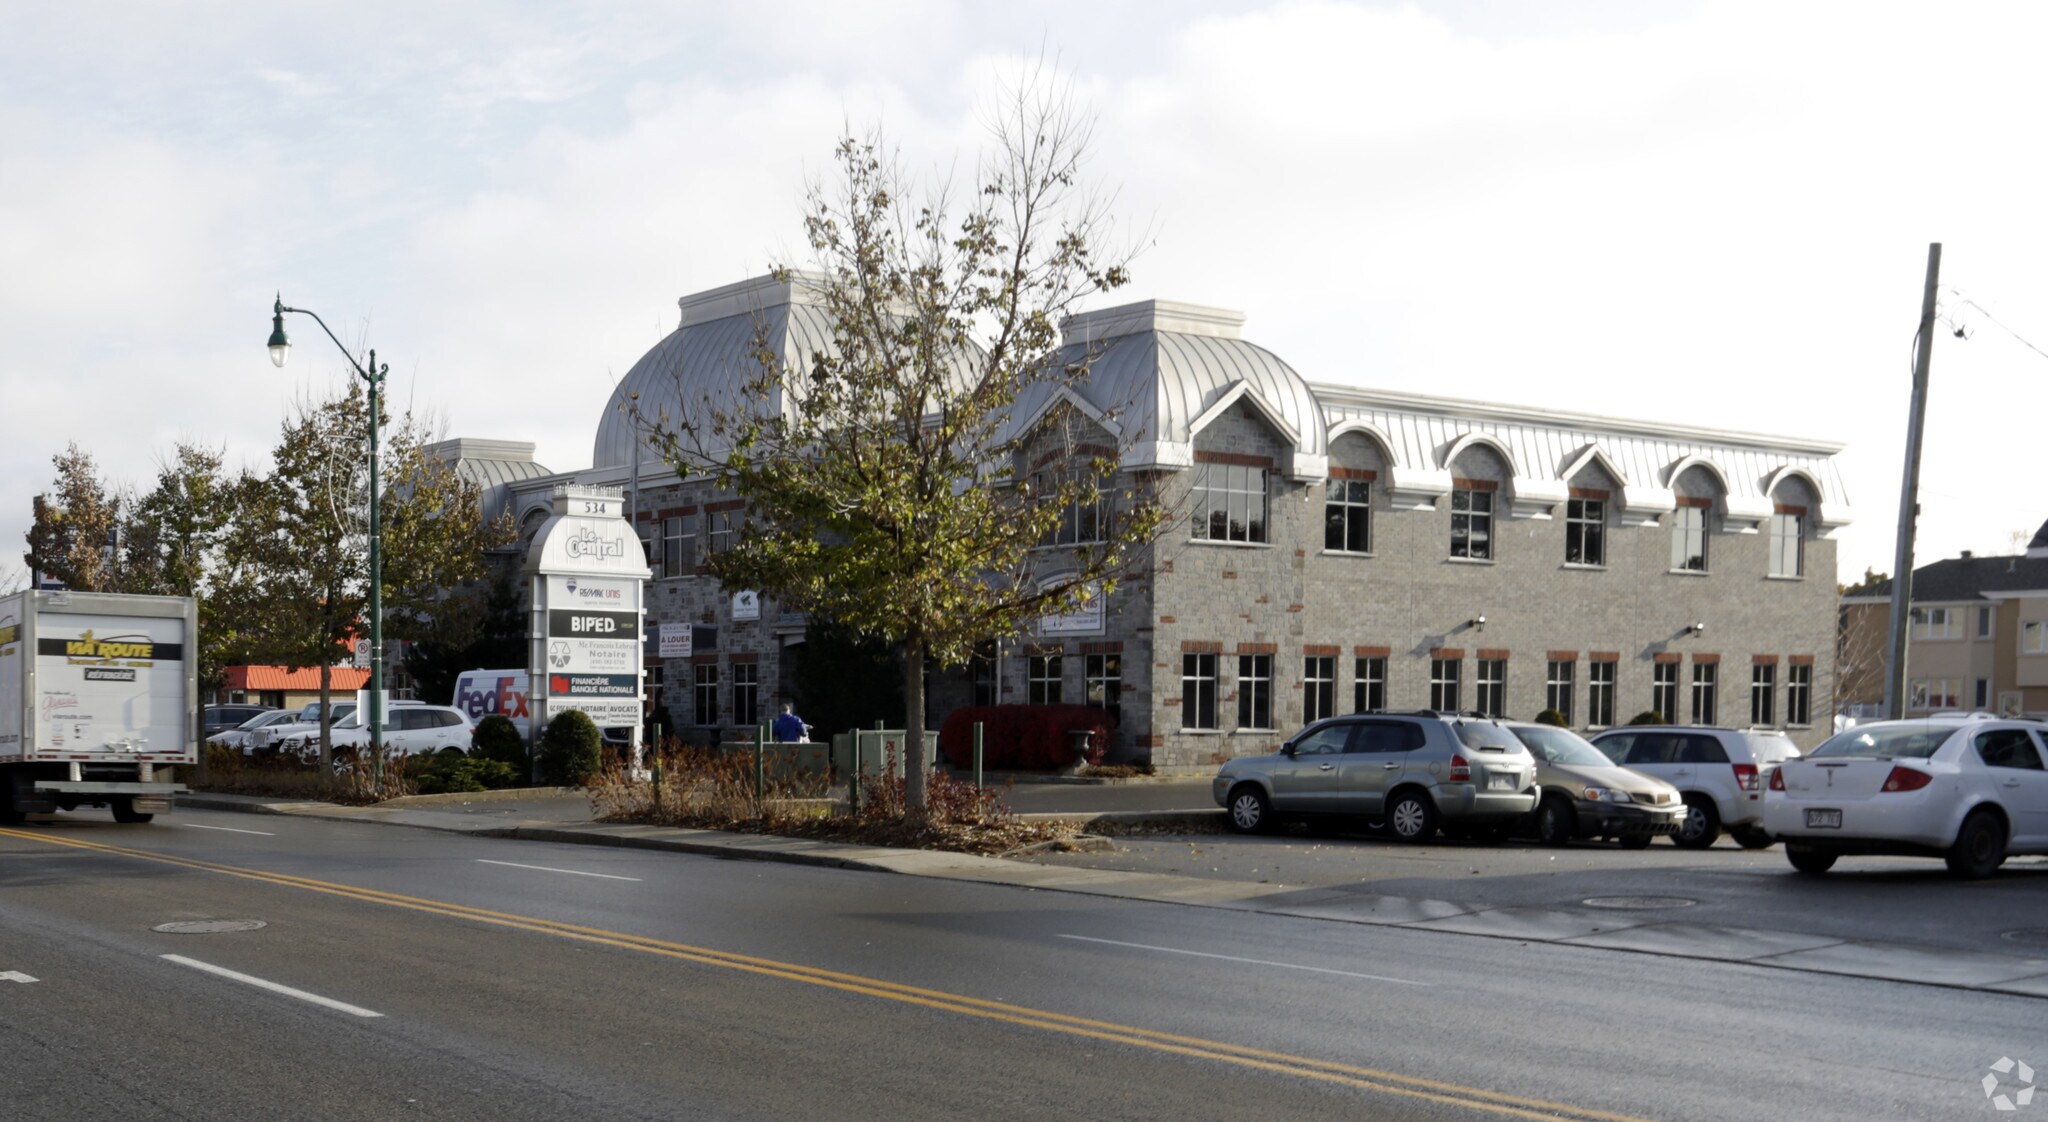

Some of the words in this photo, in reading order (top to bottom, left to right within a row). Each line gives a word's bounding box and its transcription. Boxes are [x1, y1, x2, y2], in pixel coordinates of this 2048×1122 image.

[584, 501, 606, 514] 534
[581, 527, 596, 542] Le
[565, 536, 624, 560] Central
[579, 588, 604, 598] RE/MAX
[605, 589, 621, 599] UNIS
[571, 616, 616, 633] BIPED
[667, 635, 690, 643] LOUER
[66, 641, 95, 656] VIA
[97, 643, 153, 659] ROUTE
[589, 650, 627, 658] Notaire
[599, 686, 634, 694] NATIONALE
[458, 677, 528, 719] FedEx
